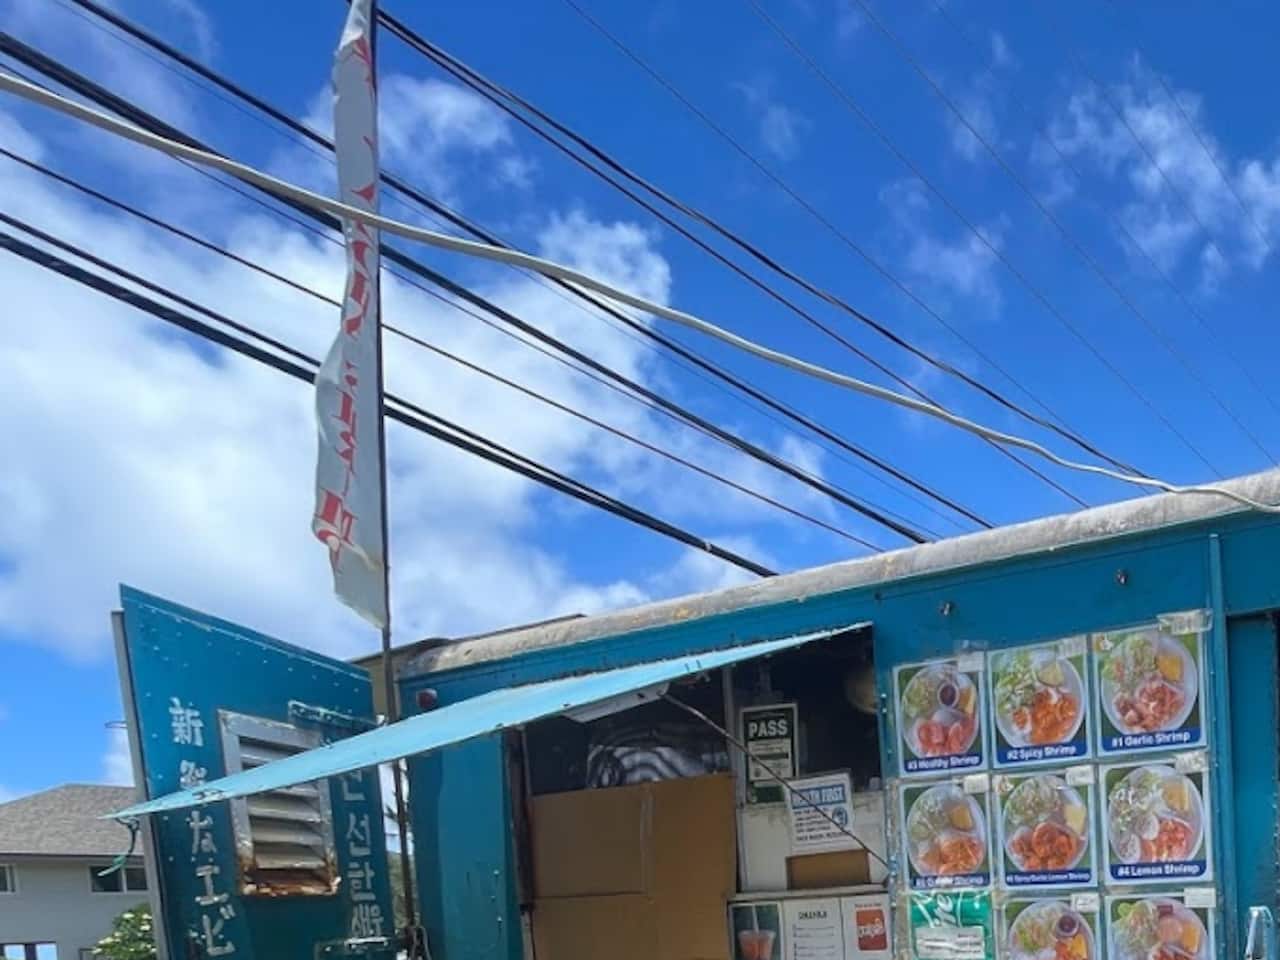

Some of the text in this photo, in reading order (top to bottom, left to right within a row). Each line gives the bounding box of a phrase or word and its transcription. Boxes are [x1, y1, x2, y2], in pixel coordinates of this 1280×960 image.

[749, 720, 788, 737] PASS
[1125, 735, 1153, 747] Garlic
[1155, 732, 1191, 744] Shrimp
[1019, 748, 1043, 760] Spicy
[1044, 745, 1077, 757] Shrimp
[950, 754, 980, 767] Shrimp
[1130, 866, 1162, 877] Lemon
[1164, 864, 1200, 875] Shrimp
